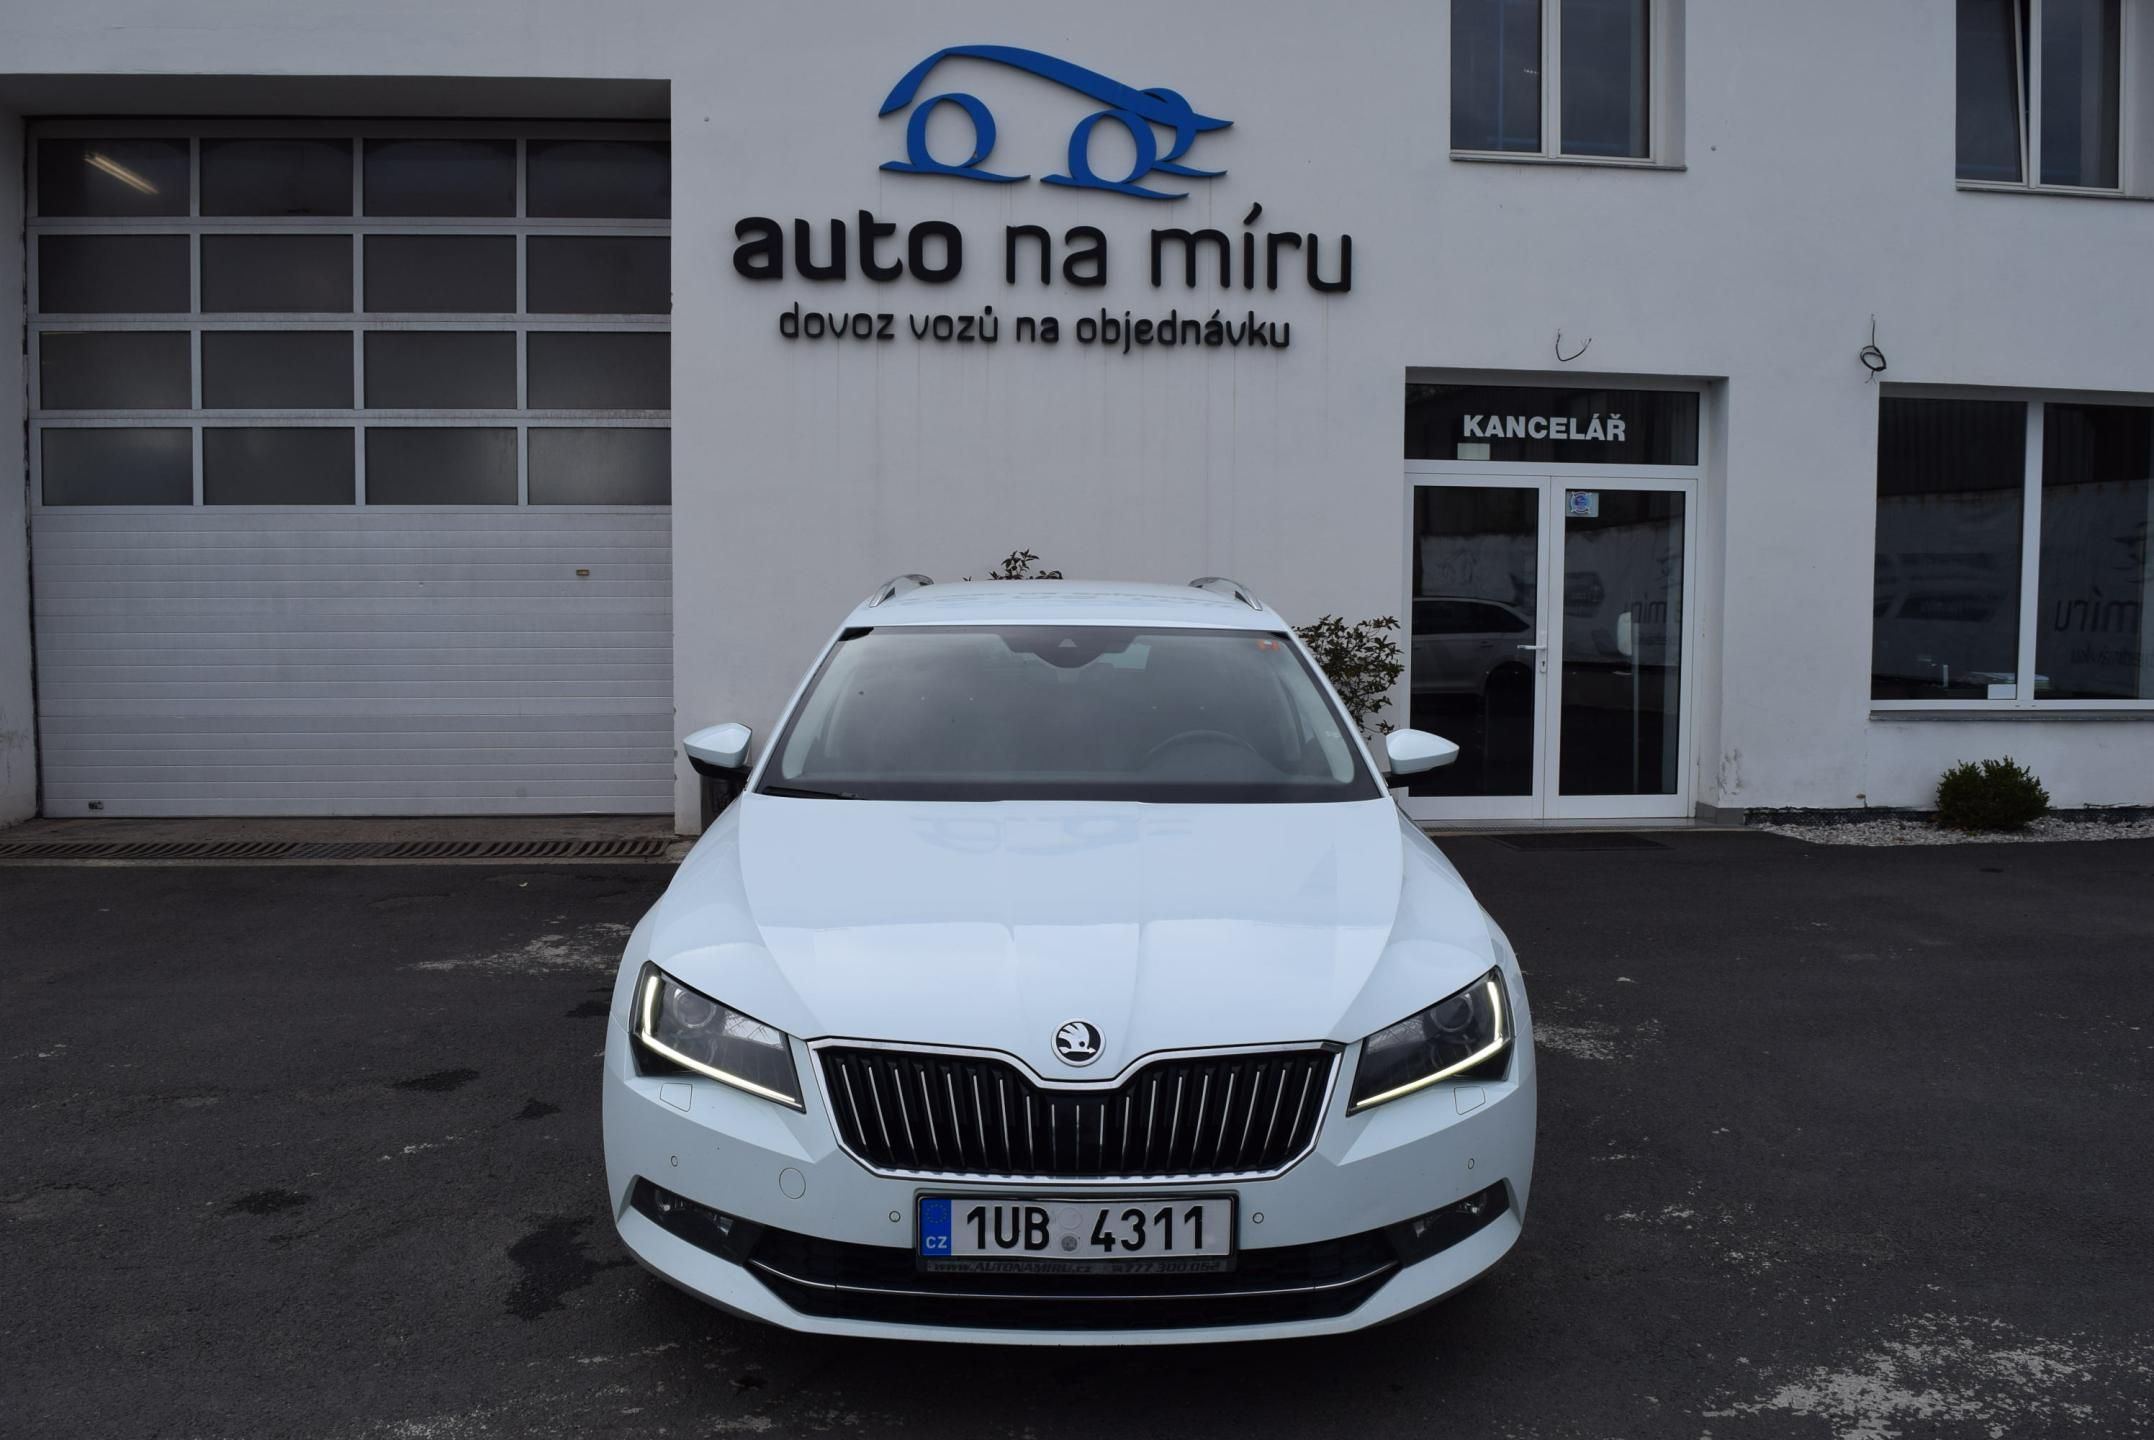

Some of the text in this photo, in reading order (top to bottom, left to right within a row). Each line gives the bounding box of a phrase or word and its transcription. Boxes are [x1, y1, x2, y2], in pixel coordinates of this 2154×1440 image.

[733, 202, 1353, 294] auto na míru
[779, 301, 1290, 356] dovoz vozů na objednávku
[1463, 413, 1626, 441] KANCELÁŘ
[925, 1235, 947, 1249] CZ
[966, 1205, 1204, 1253] 1UB 4311
